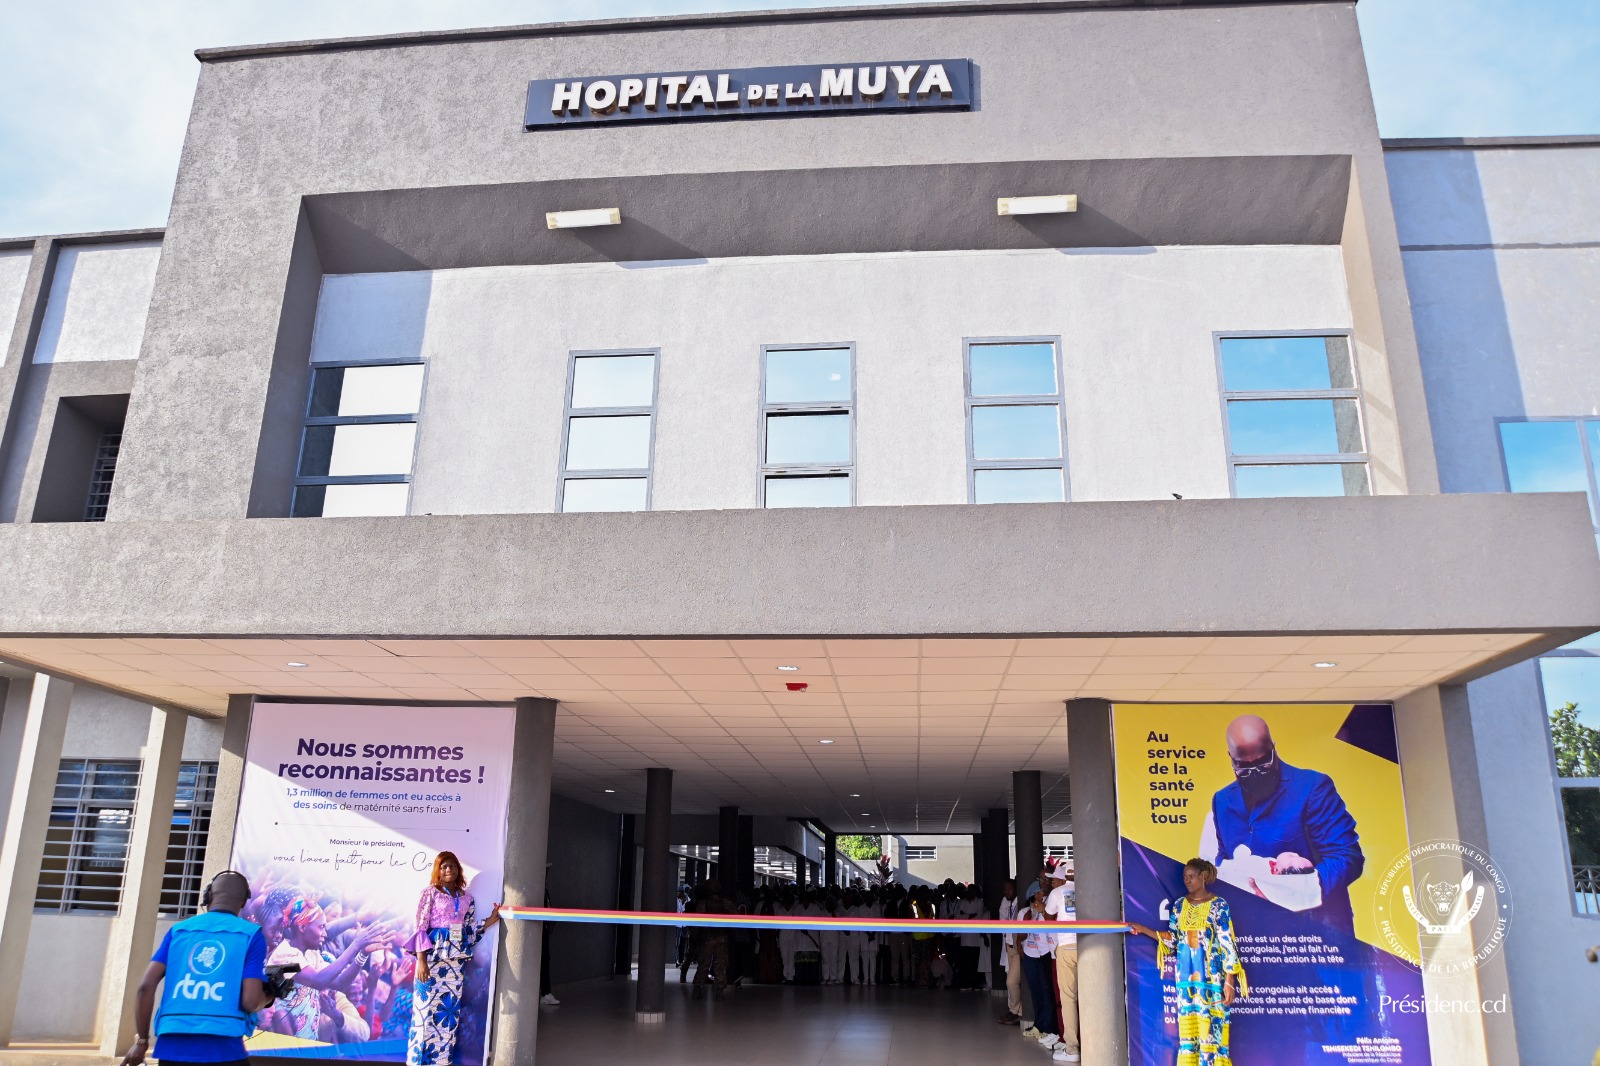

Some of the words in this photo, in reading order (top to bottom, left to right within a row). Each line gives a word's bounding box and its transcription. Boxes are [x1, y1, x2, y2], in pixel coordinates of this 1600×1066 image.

[551, 73, 739, 117] HOPITAL
[747, 82, 779, 101] DE
[785, 82, 814, 100] LA
[818, 64, 954, 99] MUYA
[1146, 730, 1169, 743] Au
[297, 738, 357, 759] Nous
[362, 745, 464, 761] sommes
[1147, 746, 1206, 759] service
[278, 761, 472, 784] reconnaissantes
[1148, 762, 1169, 775] de
[1173, 762, 1188, 775] la
[1149, 778, 1195, 791] santé
[286, 788, 298, 798] 1,3
[300, 789, 333, 798] million
[335, 790, 348, 799] de
[350, 790, 390, 800] femmes
[391, 793, 408, 801] ont
[425, 792, 453, 802] accès
[455, 793, 462, 802] à
[293, 800, 310, 809] des
[312, 801, 338, 811] soins
[339, 802, 352, 811] de
[426, 805, 447, 814] frais
[1150, 797, 1189, 811] pour
[1151, 811, 1187, 824] tous
[329, 838, 361, 846] Monsieur
[370, 840, 405, 848] président,
[335, 850, 363, 871] fait
[360, 856, 385, 872] pour
[389, 852, 407, 867] le
[1234, 935, 1253, 943] anté
[1282, 935, 1297, 943] des
[1298, 935, 1322, 943] droits
[1240, 945, 1281, 954] congolais,
[1299, 945, 1307, 953] ai
[1308, 945, 1322, 953] fait
[1250, 955, 1261, 963] de
[1284, 955, 1310, 963] action
[1311, 955, 1317, 963] à
[1318, 955, 1325, 963] la
[1326, 955, 1344, 963] tête
[172, 973, 226, 1002] rtnc
[1255, 985, 1295, 995] congolais
[1309, 985, 1333, 994] accès
[1334, 985, 1340, 994] à
[1265, 996, 1276, 1004] de
[1278, 996, 1301, 1004] santé
[1304, 996, 1315, 1004] de
[1316, 996, 1335, 1004] base
[1337, 996, 1357, 1004] dont
[1230, 1006, 1264, 1014] encourir
[1285, 1006, 1307, 1014] ruine
[1308, 1006, 1351, 1014] financière
